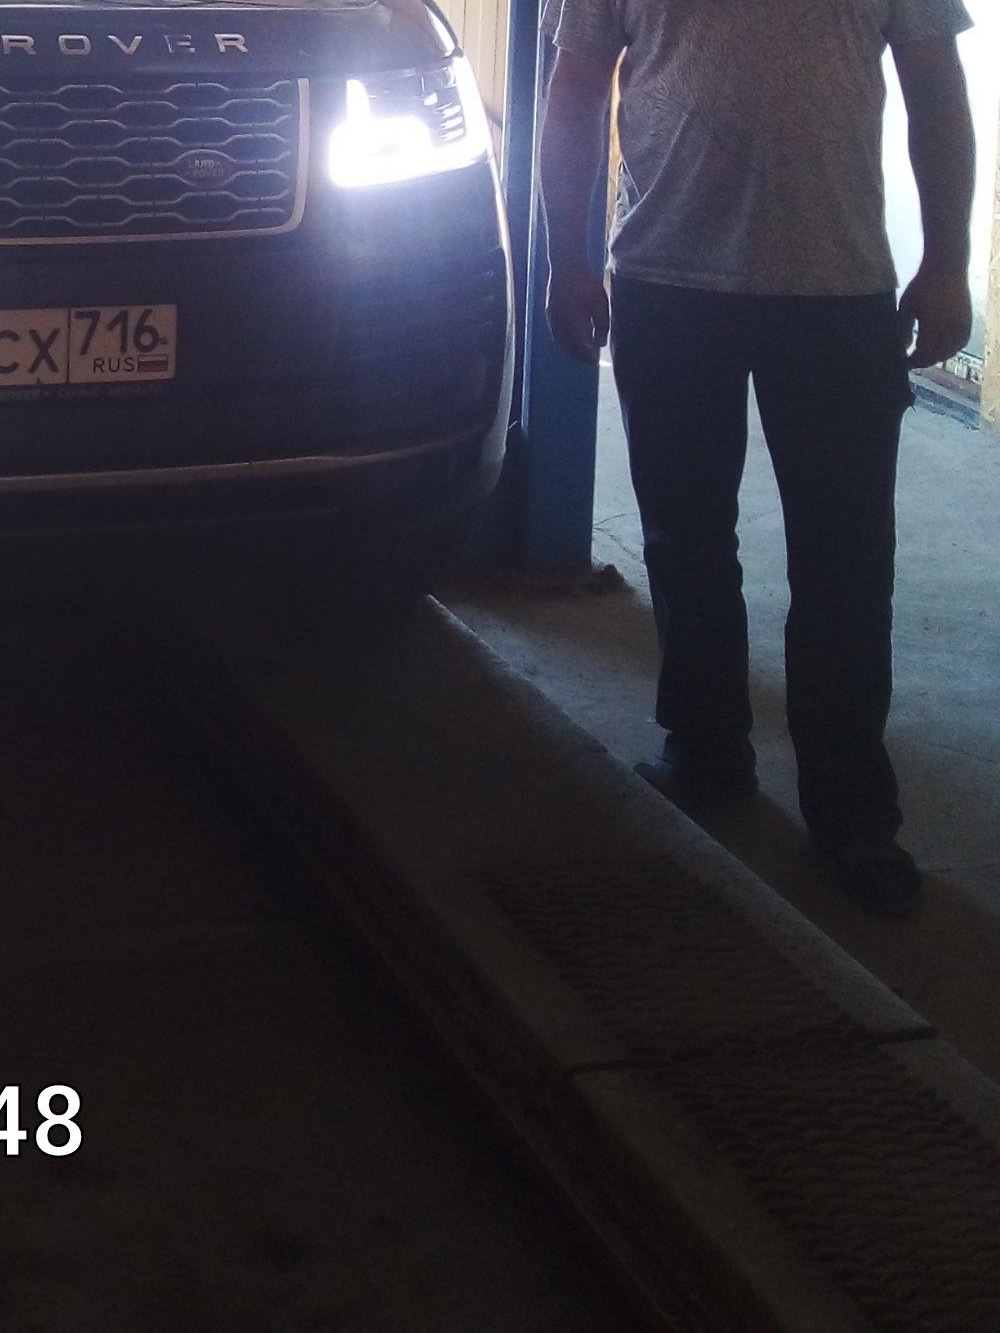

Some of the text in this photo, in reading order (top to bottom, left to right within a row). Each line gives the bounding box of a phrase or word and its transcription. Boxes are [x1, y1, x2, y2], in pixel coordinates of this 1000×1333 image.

[1, 32, 250, 56] ROVER
[75, 309, 160, 356] 716
[92, 357, 135, 374] RUS
